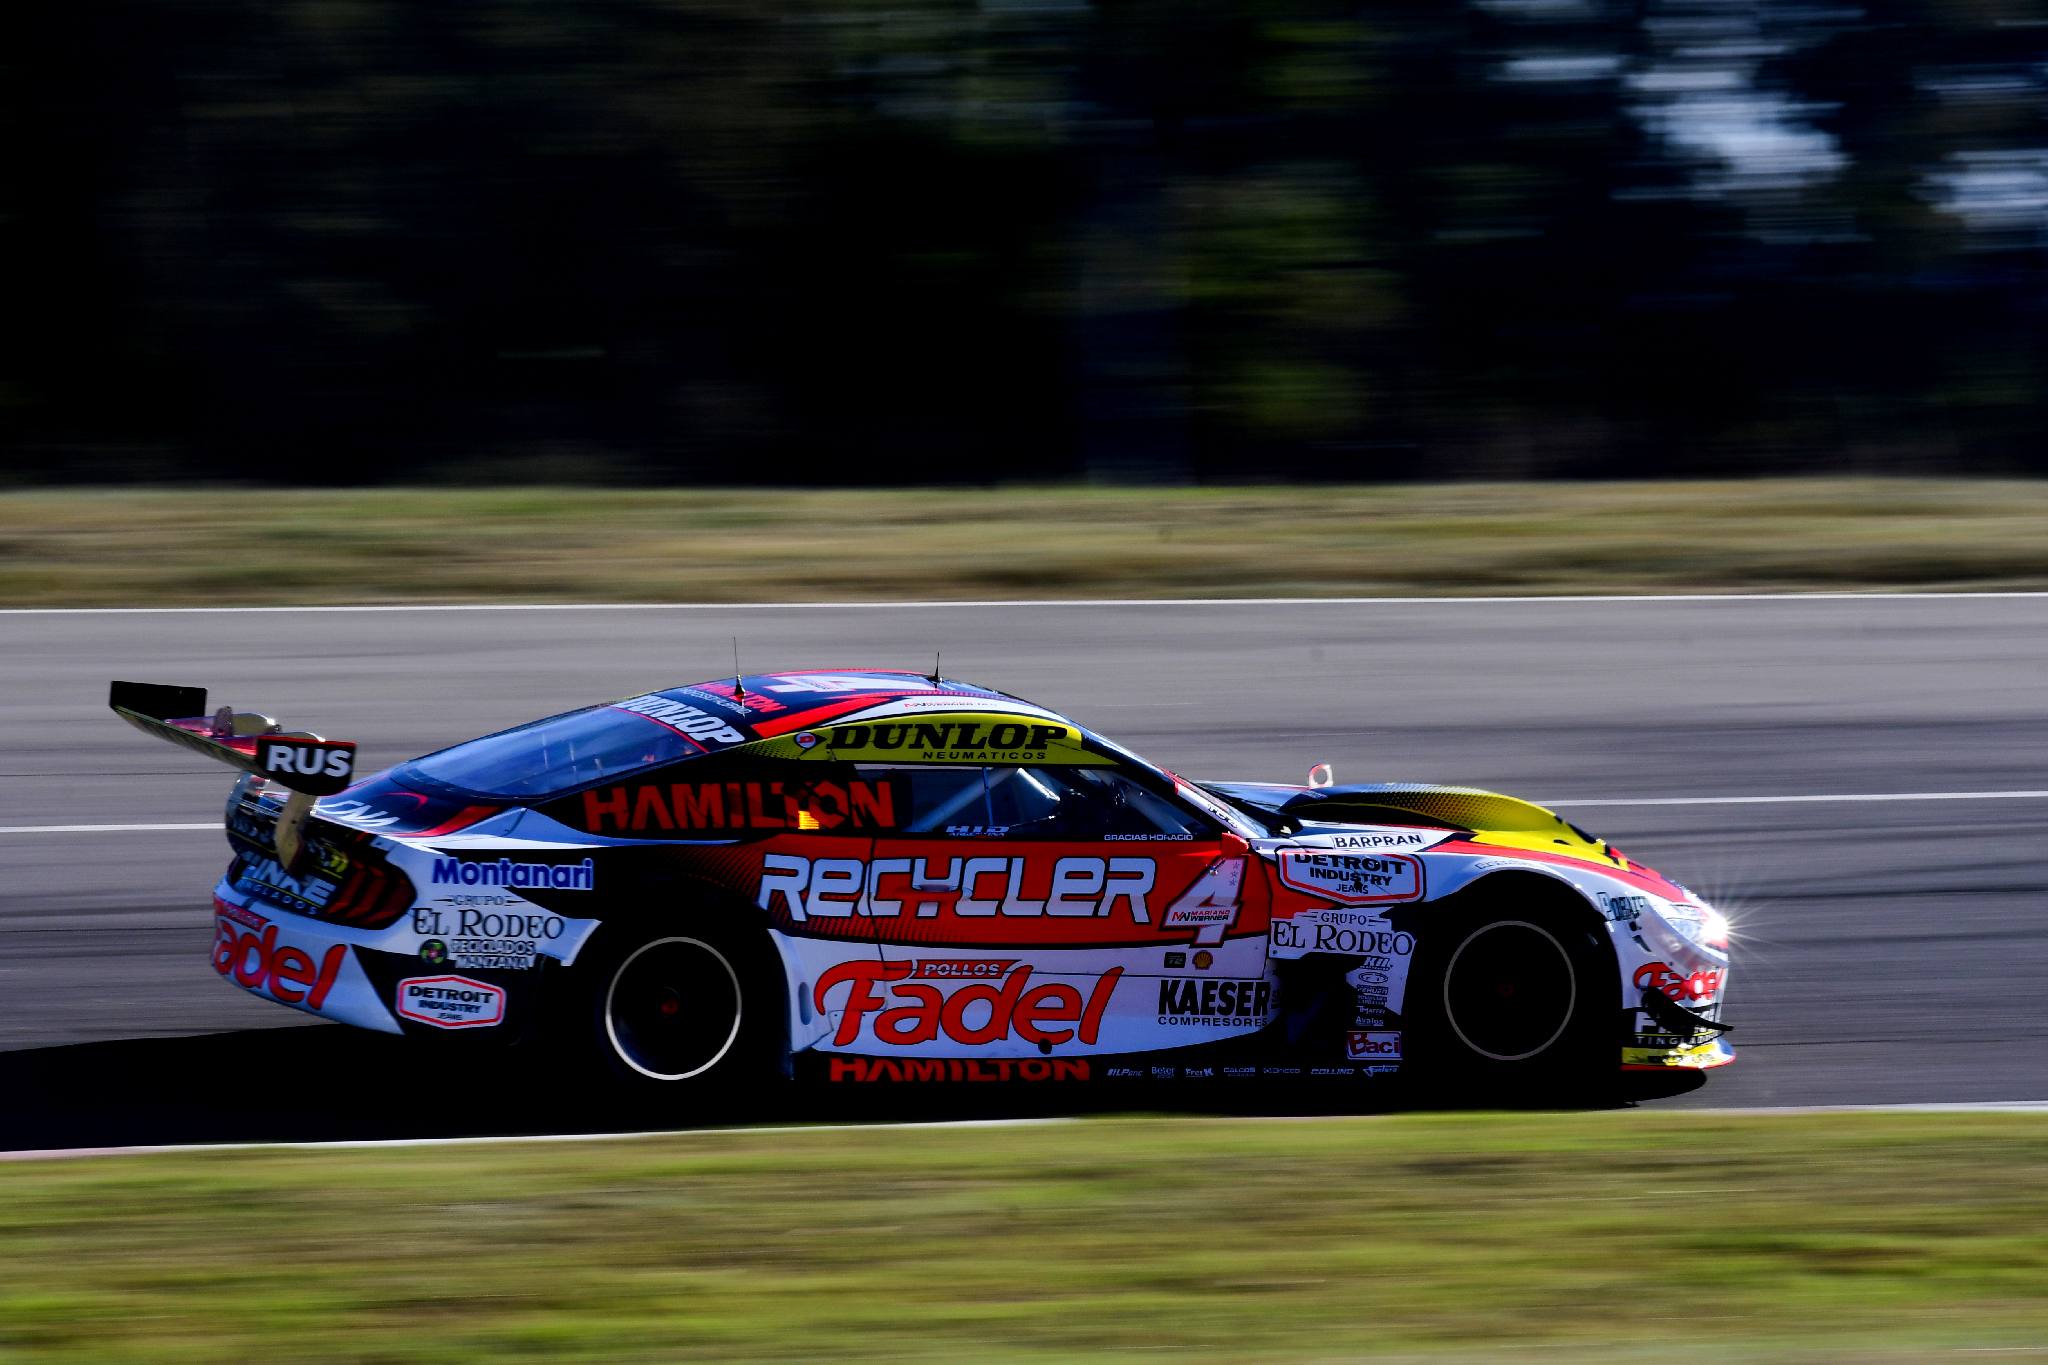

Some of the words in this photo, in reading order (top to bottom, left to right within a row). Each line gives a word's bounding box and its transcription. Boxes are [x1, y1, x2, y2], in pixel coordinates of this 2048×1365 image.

[610, 695, 746, 743] DUNLOP
[826, 723, 1068, 750] DUNLOP
[266, 745, 352, 778] RUS
[923, 751, 1047, 761] NEUMATICOS
[582, 781, 896, 831] HAMILTON
[1334, 834, 1422, 848] BARPRAN
[432, 857, 594, 890] Montanari
[1294, 854, 1406, 875] DETROIT
[1310, 867, 1393, 887] INDUSTRY
[454, 896, 504, 907] GRUPO
[1162, 856, 1248, 946] 4
[412, 908, 449, 936] EL
[456, 909, 565, 939] RODEO
[1320, 912, 1367, 925] GRUPO
[450, 939, 537, 956] RECICLADOS
[1272, 921, 1306, 948] EL
[1313, 924, 1413, 956] RODEO
[923, 963, 1001, 976] POLLOS
[408, 986, 494, 1004] DETROIT
[813, 960, 1125, 1047] Fadel
[1158, 979, 1272, 1017] KAESER
[418, 1000, 482, 1014] INDUSTRY
[1157, 1016, 1268, 1027] COMPRESORES
[1349, 1032, 1400, 1056] Baci
[829, 1059, 1090, 1082] HAMILTON
